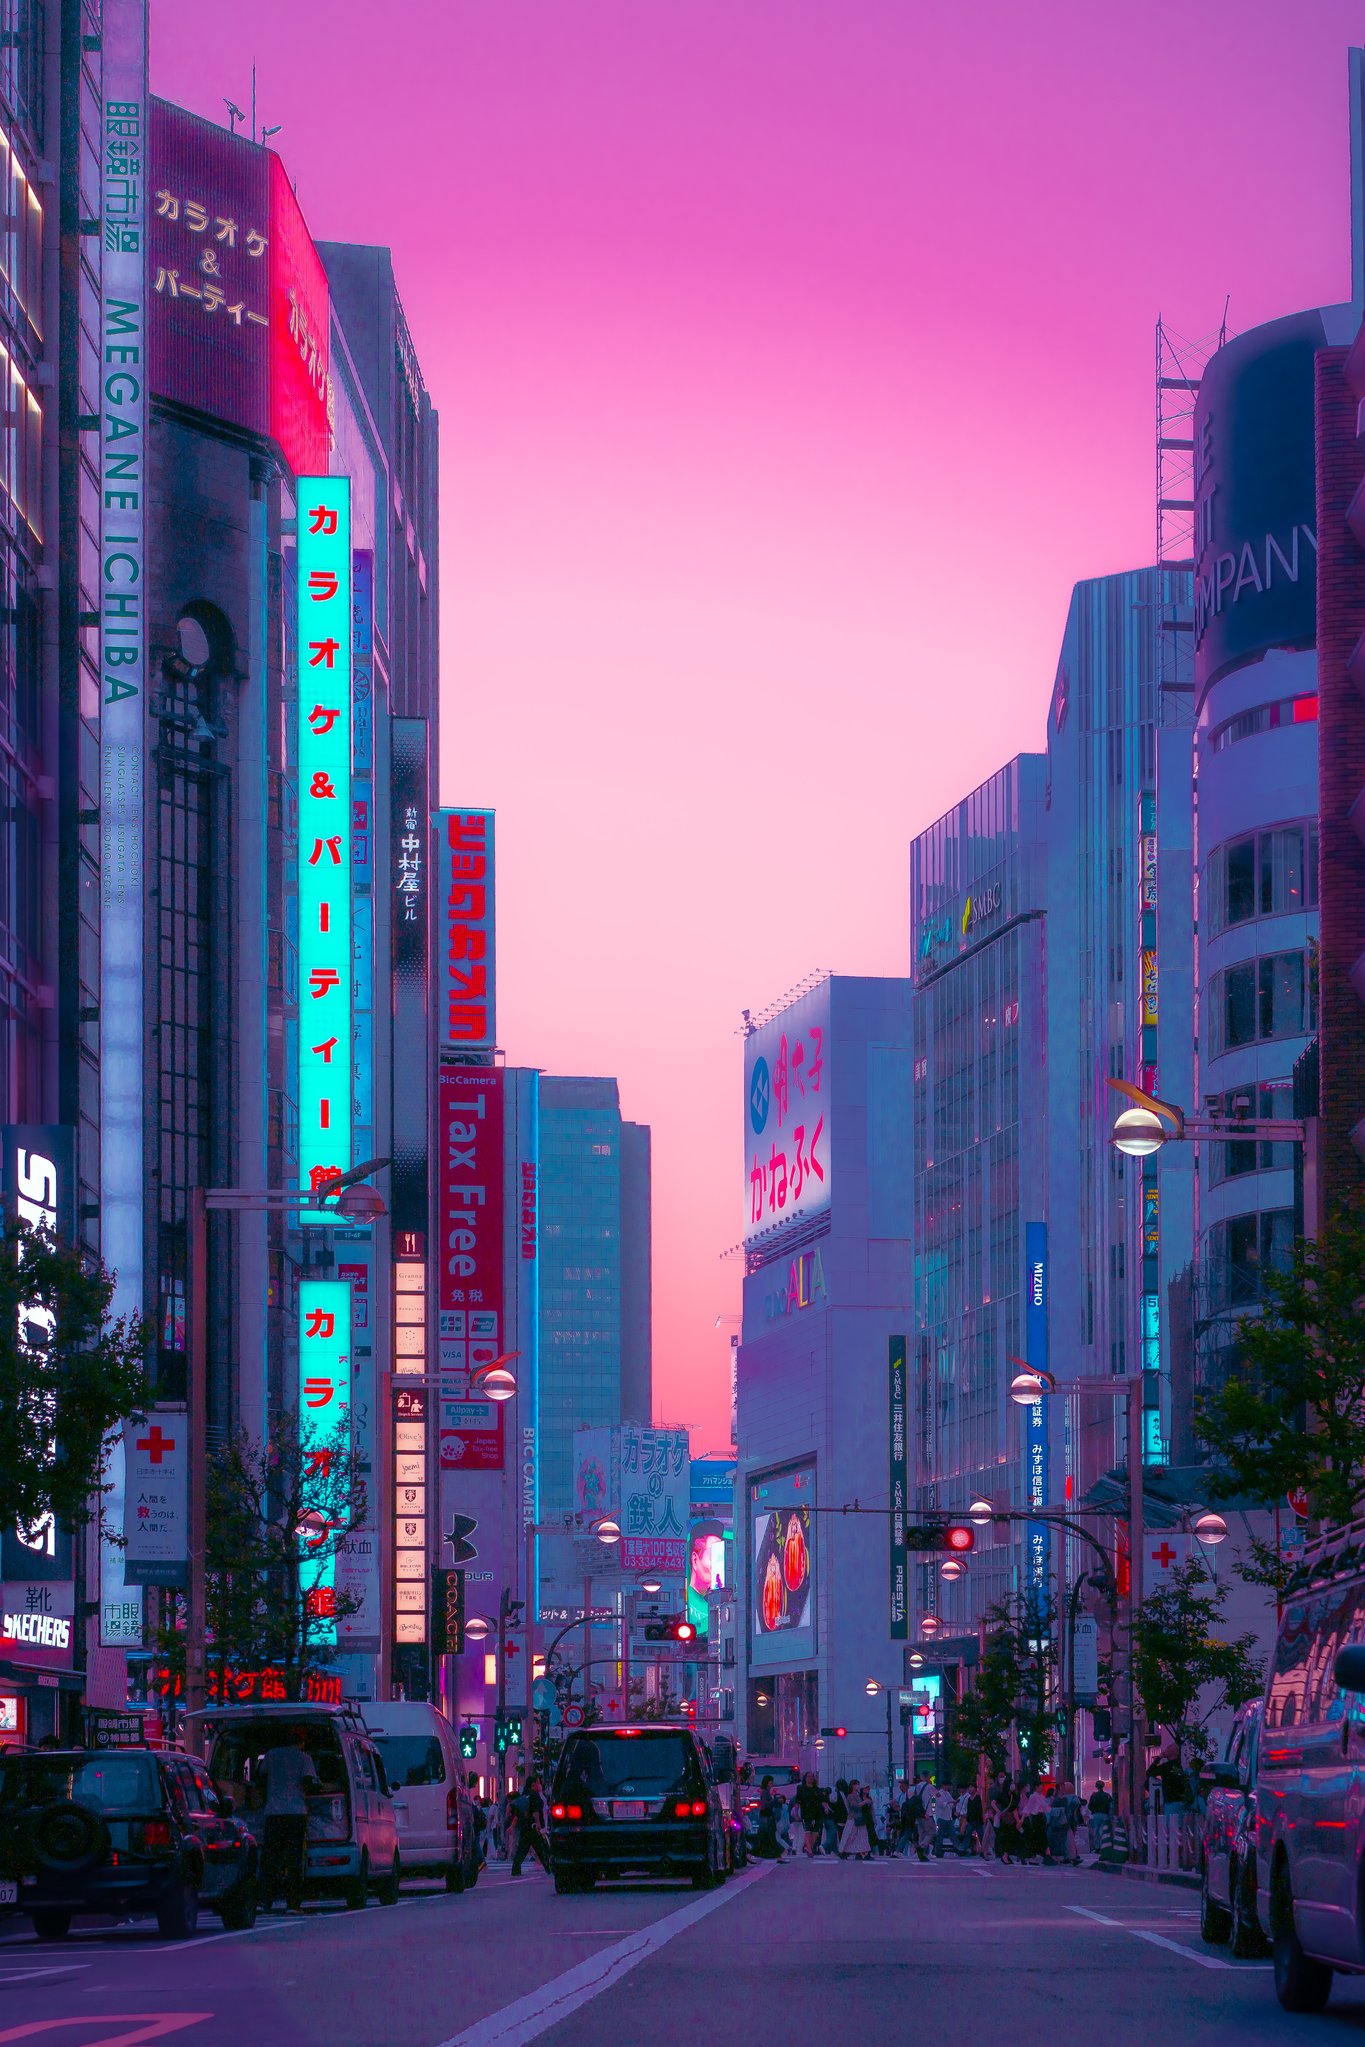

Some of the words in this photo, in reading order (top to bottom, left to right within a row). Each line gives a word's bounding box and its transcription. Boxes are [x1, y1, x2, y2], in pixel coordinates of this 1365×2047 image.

[156, 189, 269, 257] カラオケ
[202, 249, 222, 278] &
[155, 267, 270, 327] パーティー
[104, 299, 140, 511] MEGANE
[104, 538, 139, 705] ICHIBA
[972, 881, 1001, 924] SMBC
[448, 815, 487, 1040] ビックカメラ
[449, 1094, 486, 1170] Tax
[750, 1111, 825, 1225] かねふく
[449, 1185, 486, 1277] Free
[1033, 1262, 1043, 1306] MIZUHO
[442, 1351, 462, 1359] VISA
[893, 1370, 902, 1400] SMBC
[523, 1427, 535, 1457] BIC
[622, 1431, 690, 1477] カラオケ
[137, 1493, 168, 1504] 人間を
[647, 1472, 664, 1499] の
[1032, 1444, 1043, 1512] みずほ信託銀
[523, 1462, 535, 1541] CAMER
[627, 1493, 684, 1537] 鉄人
[25, 1586, 52, 1613] 靴
[3, 1614, 71, 1649] SKECHERS
